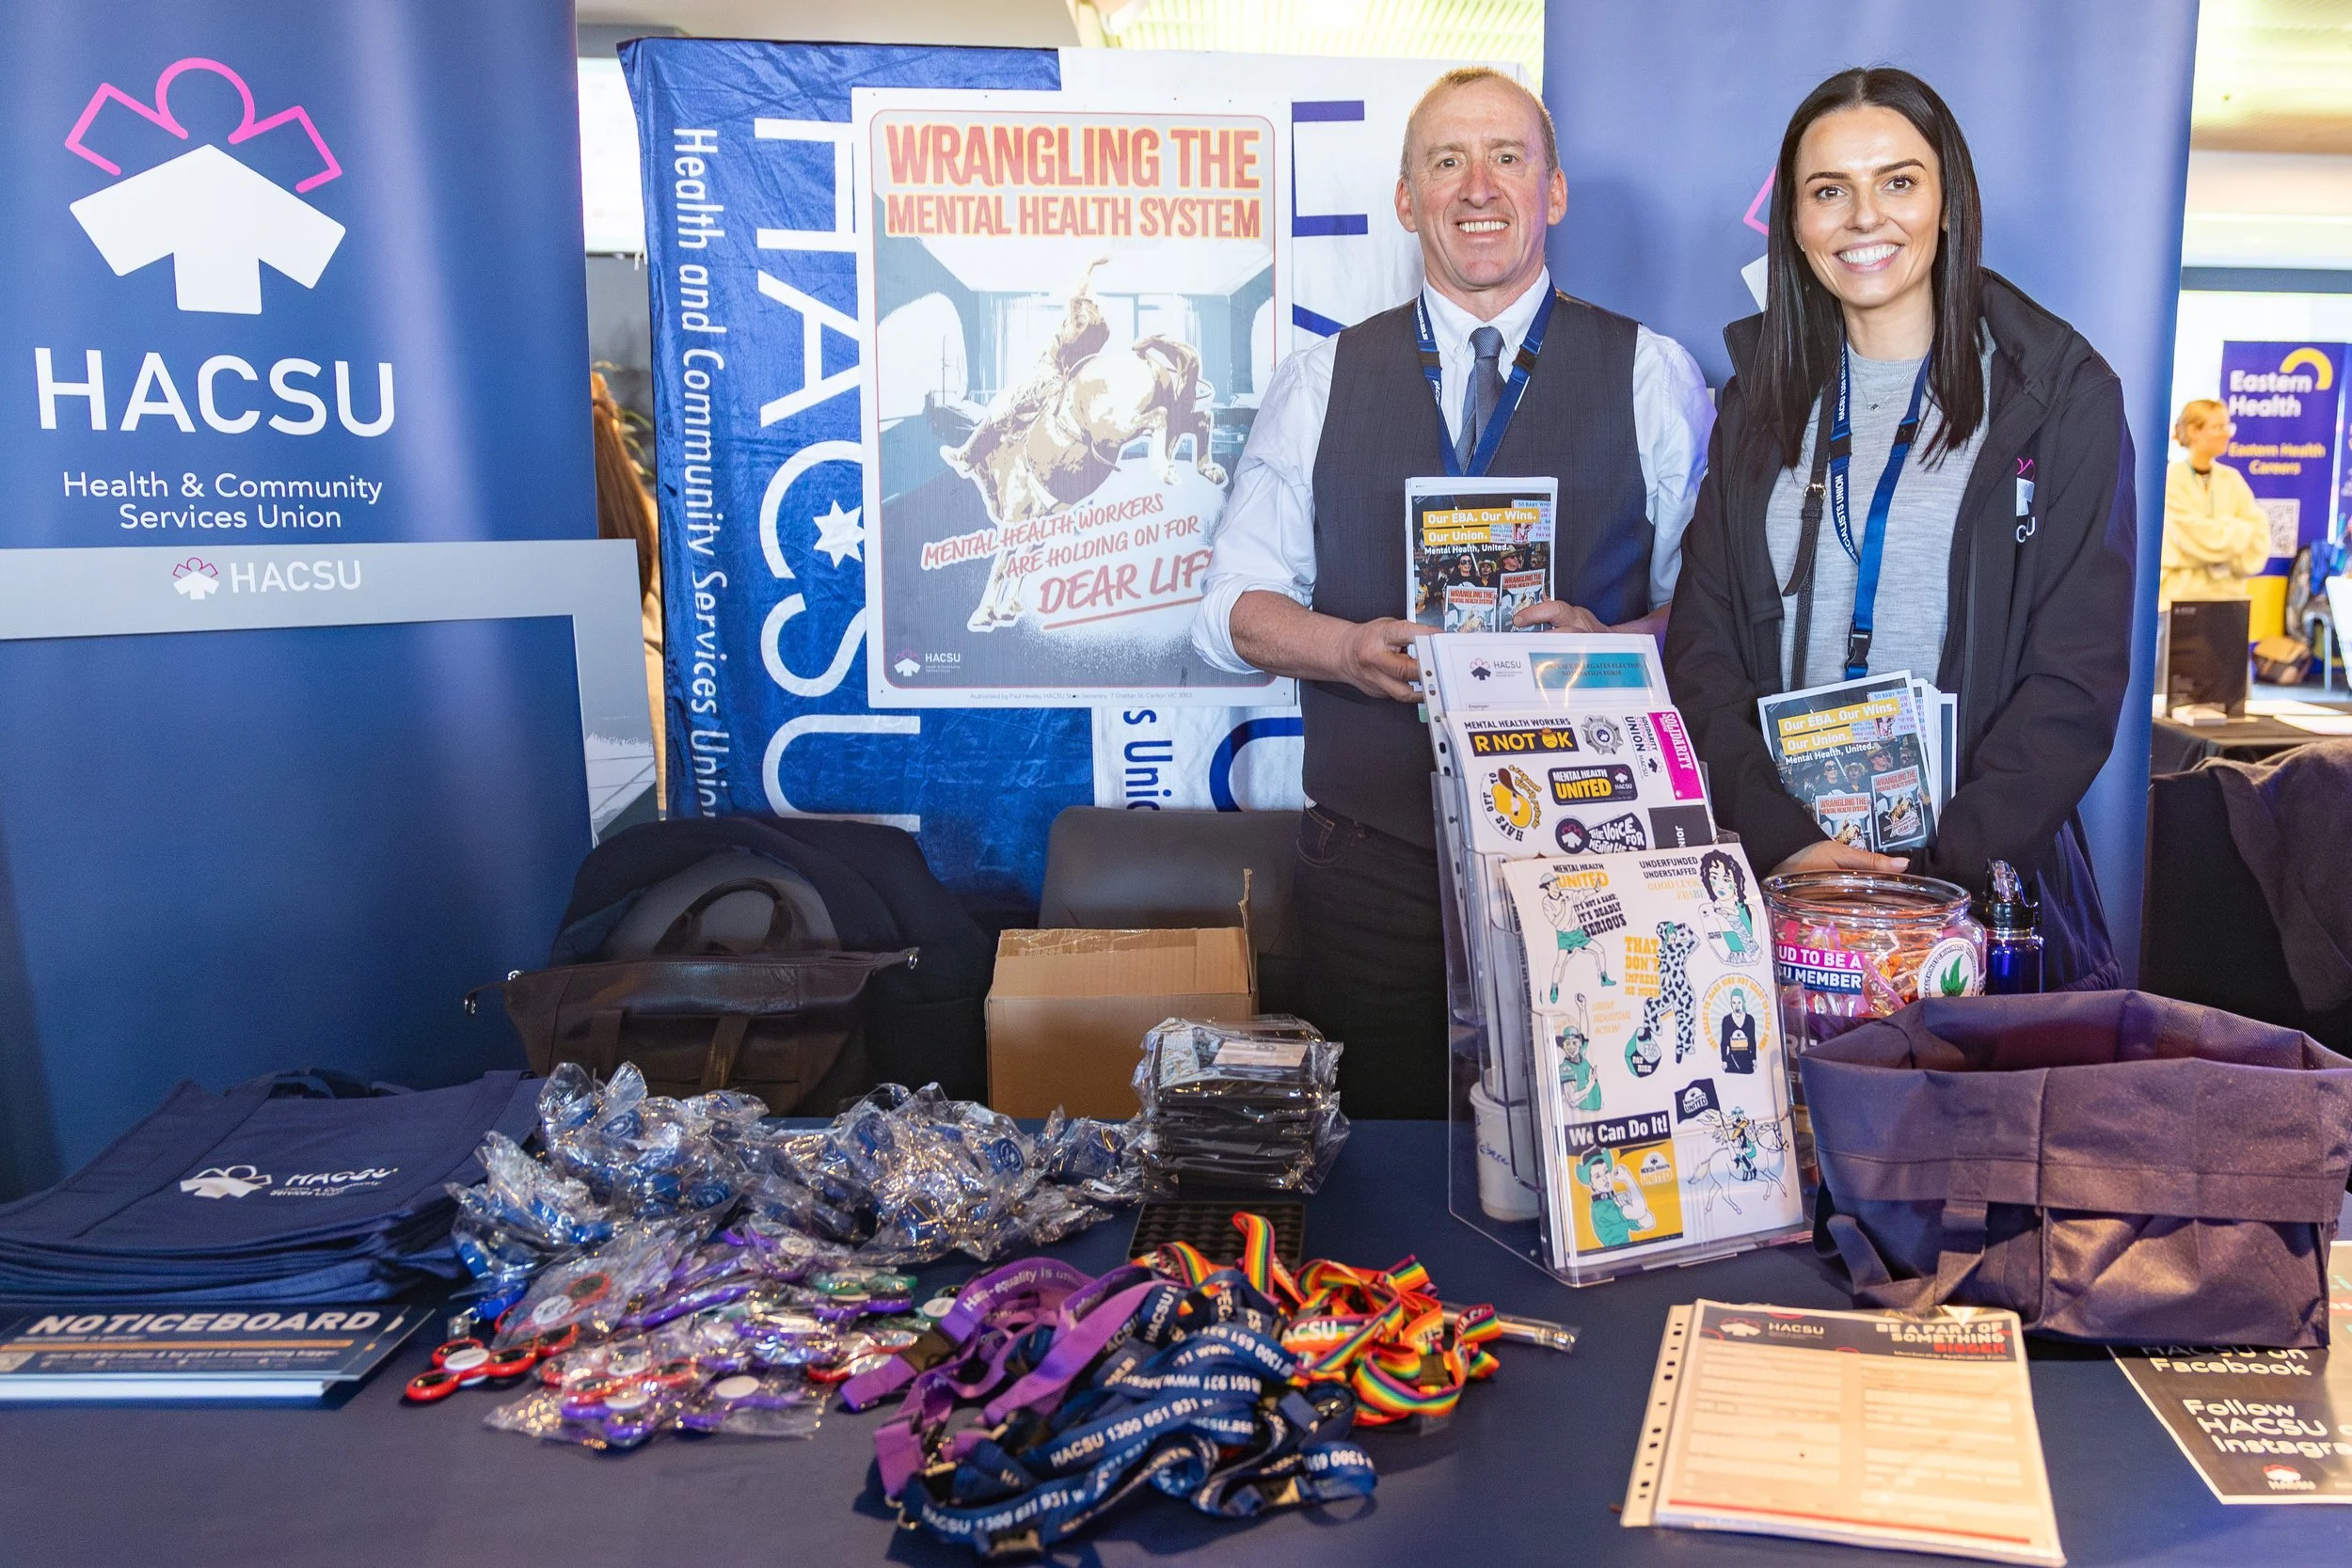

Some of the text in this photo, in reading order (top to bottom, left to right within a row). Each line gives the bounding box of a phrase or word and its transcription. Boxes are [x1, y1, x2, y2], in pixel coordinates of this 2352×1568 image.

[885, 124, 1160, 187] WRANGLING
[1170, 128, 1261, 189] THE
[674, 129, 725, 248] Health
[888, 194, 1261, 238] MENTAL HEALTH SYSTEM
[679, 265, 727, 334] and
[2230, 370, 2313, 393] Eastern
[35, 347, 395, 437] HACSU
[2228, 394, 2302, 418] Health
[683, 348, 724, 556] Community
[63, 471, 383, 504] Health & Community
[1835, 474, 1844, 504] UNION
[119, 504, 341, 529] Services Union
[1428, 510, 1536, 524] Our EBA. Our Wins.
[924, 493, 1165, 565] MENTAL HEALTH WORKERS
[1428, 531, 1449, 542] Our
[1453, 531, 1487, 541] Union.
[1006, 515, 1201, 578] ARE HOLDING ON FOR
[1424, 544, 1509, 556] Mental Health, United.
[230, 560, 361, 594] HACSU
[1038, 563, 1142, 614] DEAR
[691, 571, 728, 715] Services
[926, 653, 961, 662] HACSU
[1493, 660, 1521, 669] HACSU
[1464, 717, 1571, 730] MENTAL HEALTH WORKERS
[1784, 703, 1897, 732] Our EBA. Our Wins.
[1474, 735, 1490, 752] R
[1493, 732, 1535, 751] NOT
[1625, 716, 1646, 752] UNION
[1661, 713, 1694, 769] SOLIDARITY
[1788, 732, 1850, 751] Our Union.
[1785, 741, 1875, 765] Mental Health, United.
[1638, 754, 1648, 777] HACSU
[1551, 769, 1608, 783] MENTAL HEALTH
[1554, 780, 1613, 800] UNITED
[1856, 797, 1867, 805] THE
[1588, 828, 1605, 840] THE
[1626, 832, 1645, 846] FOR
[1553, 864, 1580, 873] MENTAL
[1639, 857, 1698, 869] UNDERFUNDED
[1643, 867, 1697, 879] UNDERSTAFFED
[1556, 872, 1609, 888] UNITED
[1594, 902, 1622, 918] DEADLY
[1582, 913, 1627, 938] SERIOUS
[1624, 936, 1660, 954] THAT
[1801, 950, 1820, 965] TO
[1824, 952, 1846, 968] BE
[1850, 952, 1862, 969] A
[1624, 973, 1660, 986] IMPRESS
[1795, 970, 1862, 989] MEMBER
[1597, 1120, 1627, 1141] Can
[1629, 1117, 1647, 1137] Do
[1649, 1114, 1668, 1134] It!
[1640, 1172, 1673, 1184] UNITED
[27, 1311, 382, 1334] NOTICEBOARD
[1768, 1322, 1825, 1336] HACSU
[1876, 1322, 2003, 1334] BE A PART OF
[1891, 1332, 2005, 1343] SOMETHING
[1933, 1342, 2006, 1354] BIGGER
[2150, 1357, 2312, 1376] Facebook
[2183, 1399, 2295, 1417] Follow
[1050, 1432, 1105, 1467] HACSU
[1105, 1418, 1142, 1442] 1300
[1143, 1406, 1170, 1428] 651
[1171, 1398, 1200, 1416] 931
[2197, 1417, 2328, 1437] HACSU
[1041, 1490, 1069, 1511] 931
